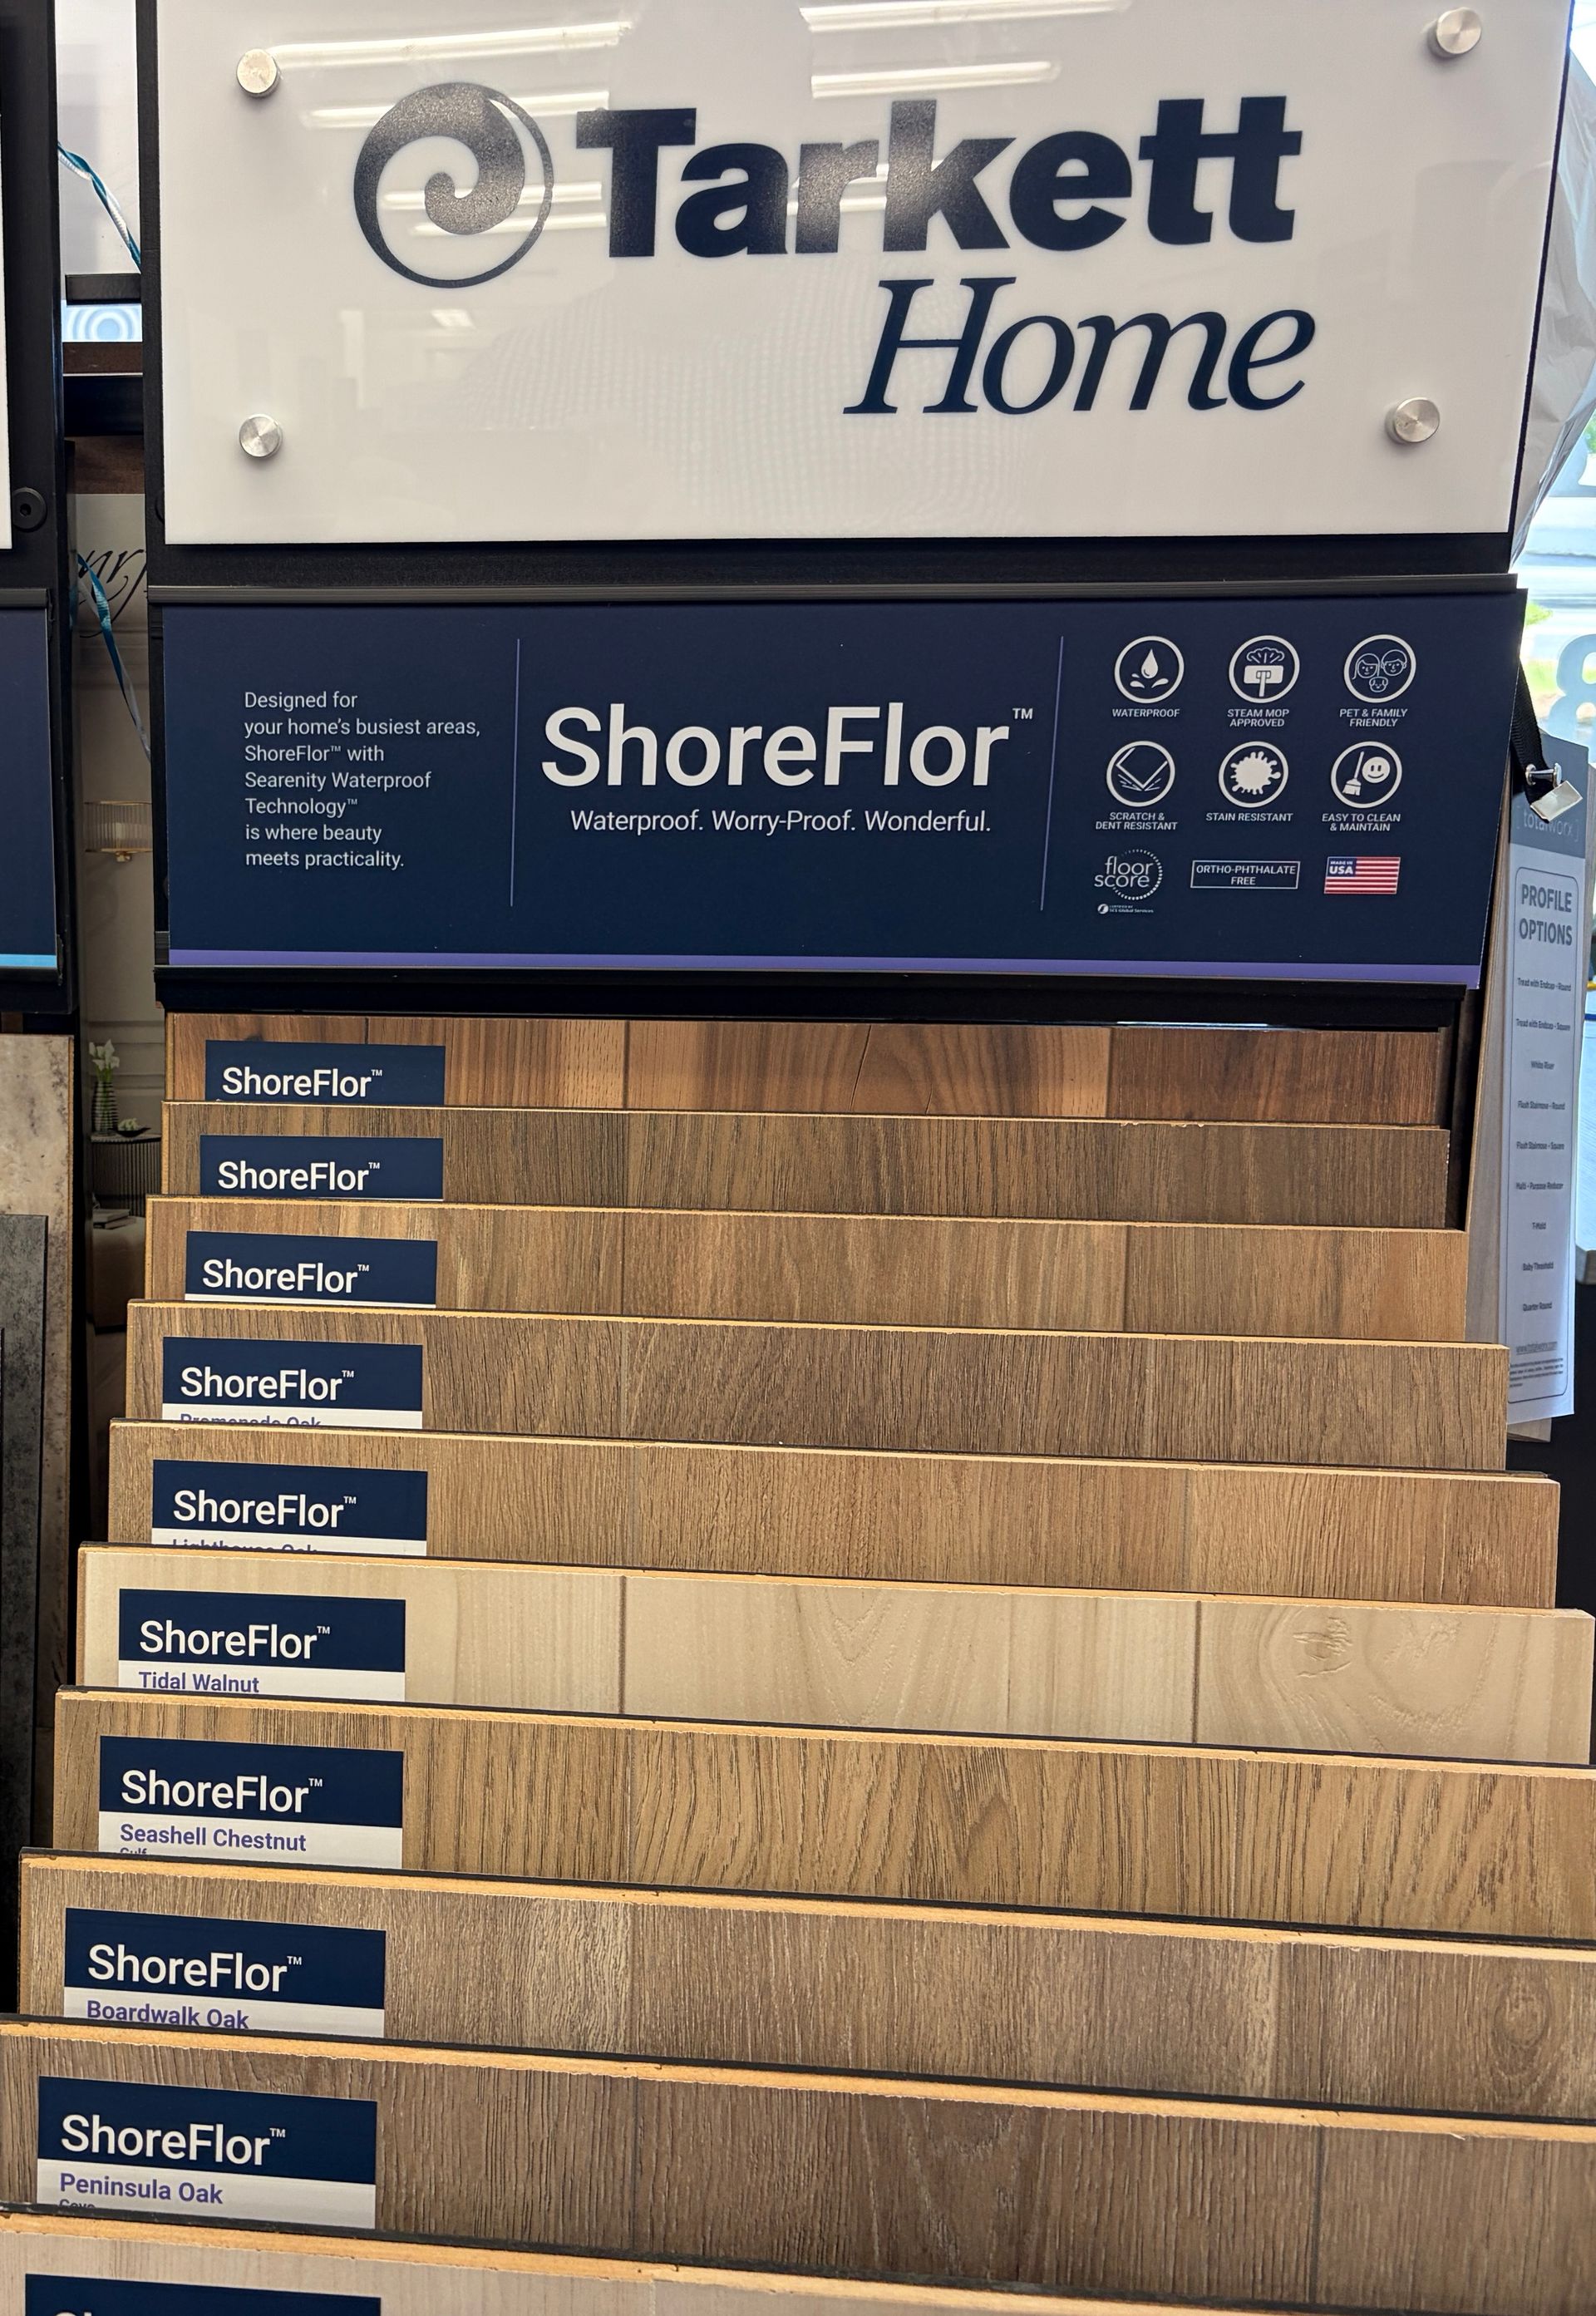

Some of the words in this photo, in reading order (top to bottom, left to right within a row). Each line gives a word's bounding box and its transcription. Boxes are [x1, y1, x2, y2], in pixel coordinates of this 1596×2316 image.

[577, 96, 1303, 258] Tarkett
[843, 277, 1315, 415] Home
[245, 692, 326, 712] Designed
[333, 691, 357, 707] for
[244, 722, 283, 738] your
[357, 718, 421, 734] busiest
[426, 722, 480, 737] areas,
[1350, 718, 1397, 727] FRIENDLY
[347, 745, 383, 761] with
[542, 702, 1032, 786] ShoreFlor™
[245, 772, 326, 791] Searenity
[332, 771, 431, 791] Waterproof
[571, 809, 702, 835] Waterproof.
[712, 810, 855, 835] Worry-Proof.
[865, 810, 990, 831] Wonderful.
[1110, 812, 1155, 820] SCRATCH
[1239, 813, 1293, 821] RESISTANT
[246, 825, 259, 840] is
[265, 824, 318, 840] where
[323, 825, 382, 844] beauty
[246, 852, 299, 865] meets
[306, 850, 403, 870] practicality.
[1104, 855, 1155, 875] floor
[1195, 865, 1298, 875] ORTHO-PHTHALATE
[1329, 865, 1353, 875] USA
[1094, 875, 1150, 888] score
[1230, 875, 1257, 886] FREE
[1521, 884, 1572, 913] PROFILE
[1519, 918, 1572, 946] OPTIONS
[223, 1067, 382, 1096] ShoreFlor™
[219, 1160, 380, 1190] ShoreFlor™
[203, 1259, 369, 1293] ShoreFlor™
[181, 1367, 353, 1400] ShoreFlor™
[173, 1490, 356, 1528] ShoreFlor™
[140, 1620, 330, 1658] ShoreFlor™
[138, 1670, 186, 1689] Tidal
[192, 1673, 259, 1693] Walnut
[121, 1770, 323, 1813] ShoreFlor™
[120, 1822, 207, 1846] Seashell
[212, 1827, 308, 1852] Chestnut
[87, 1944, 303, 1992] ShoreFlor™
[86, 1999, 200, 2026] Boardwalk
[206, 2008, 249, 2029] Oak
[61, 2115, 285, 2166] ShoreFlor™
[60, 2172, 171, 2200] Peninsula
[178, 2181, 224, 2205] Oak
